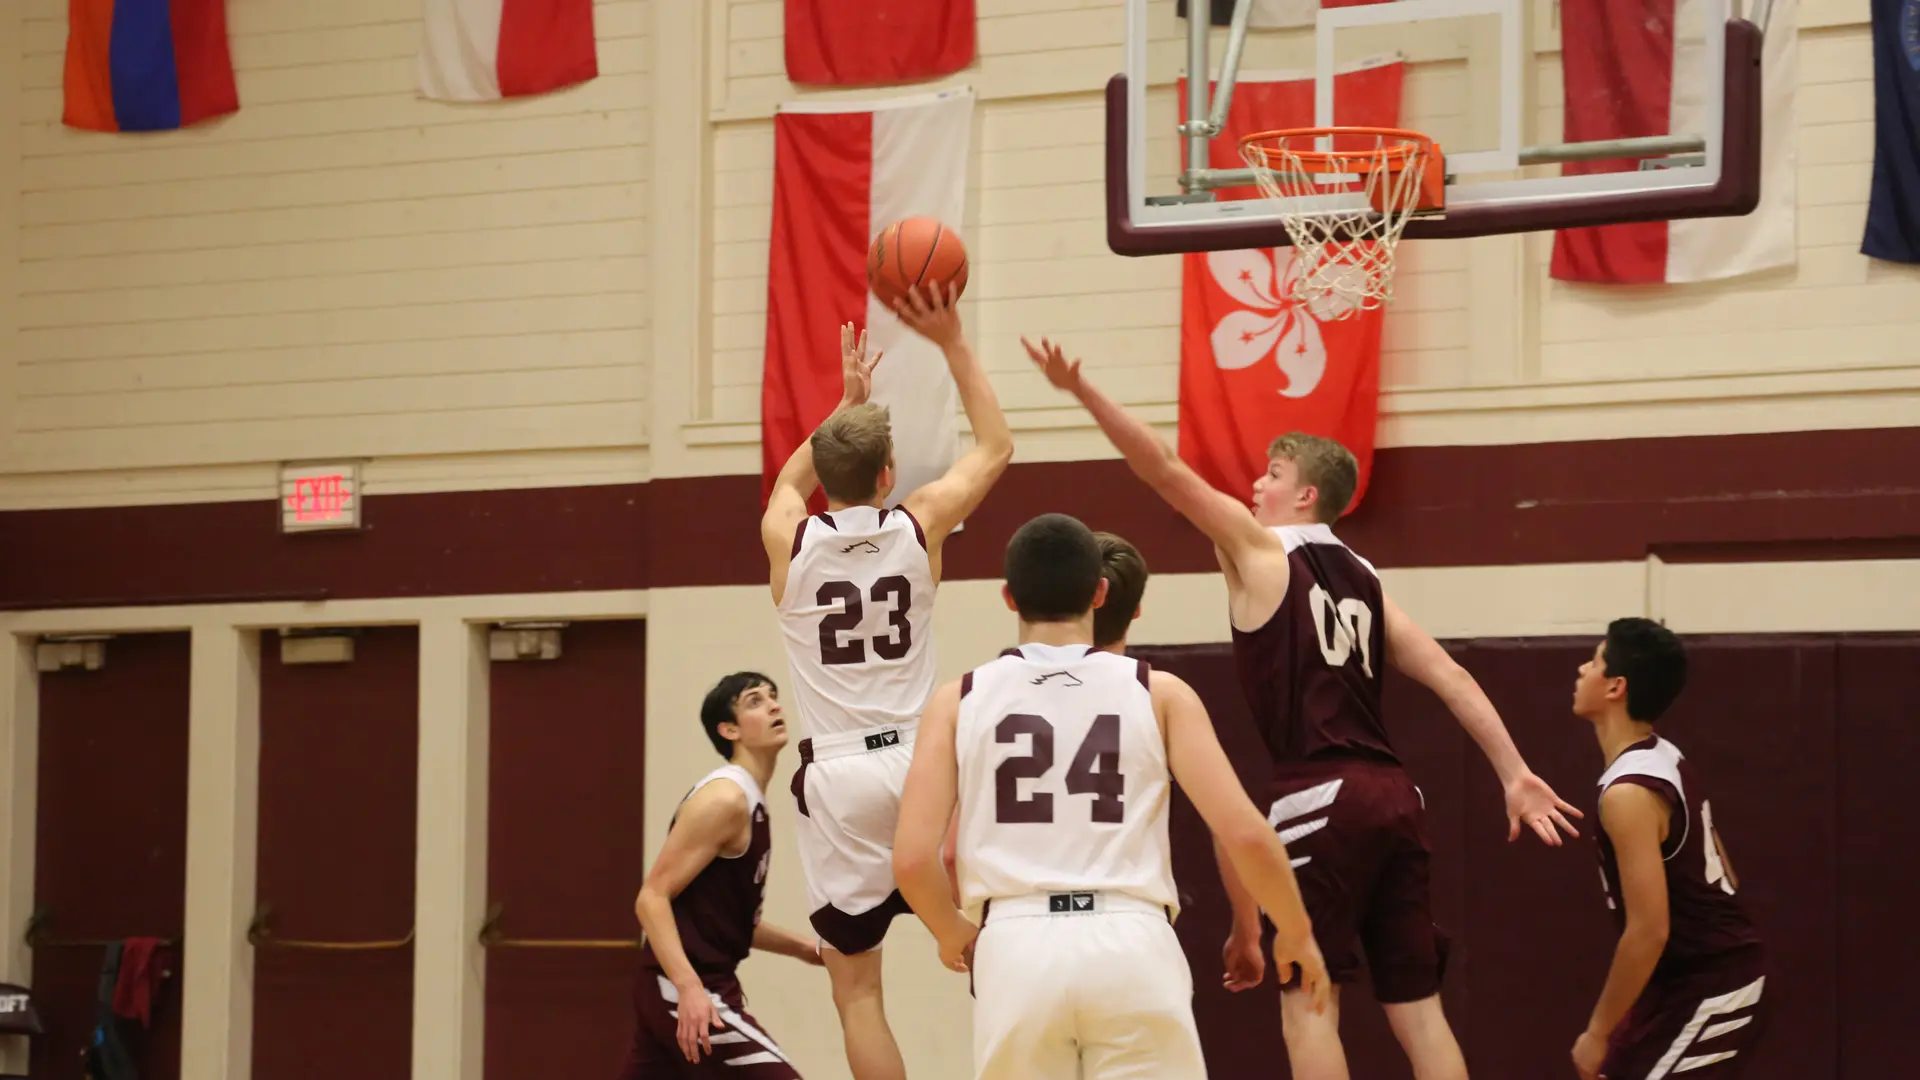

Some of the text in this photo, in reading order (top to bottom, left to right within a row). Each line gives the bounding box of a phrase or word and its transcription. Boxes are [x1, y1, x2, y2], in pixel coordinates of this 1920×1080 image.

[295, 474, 343, 521] EXIT
[816, 575, 912, 664] 23
[1309, 582, 1373, 678] 00
[995, 713, 1124, 823] 24
